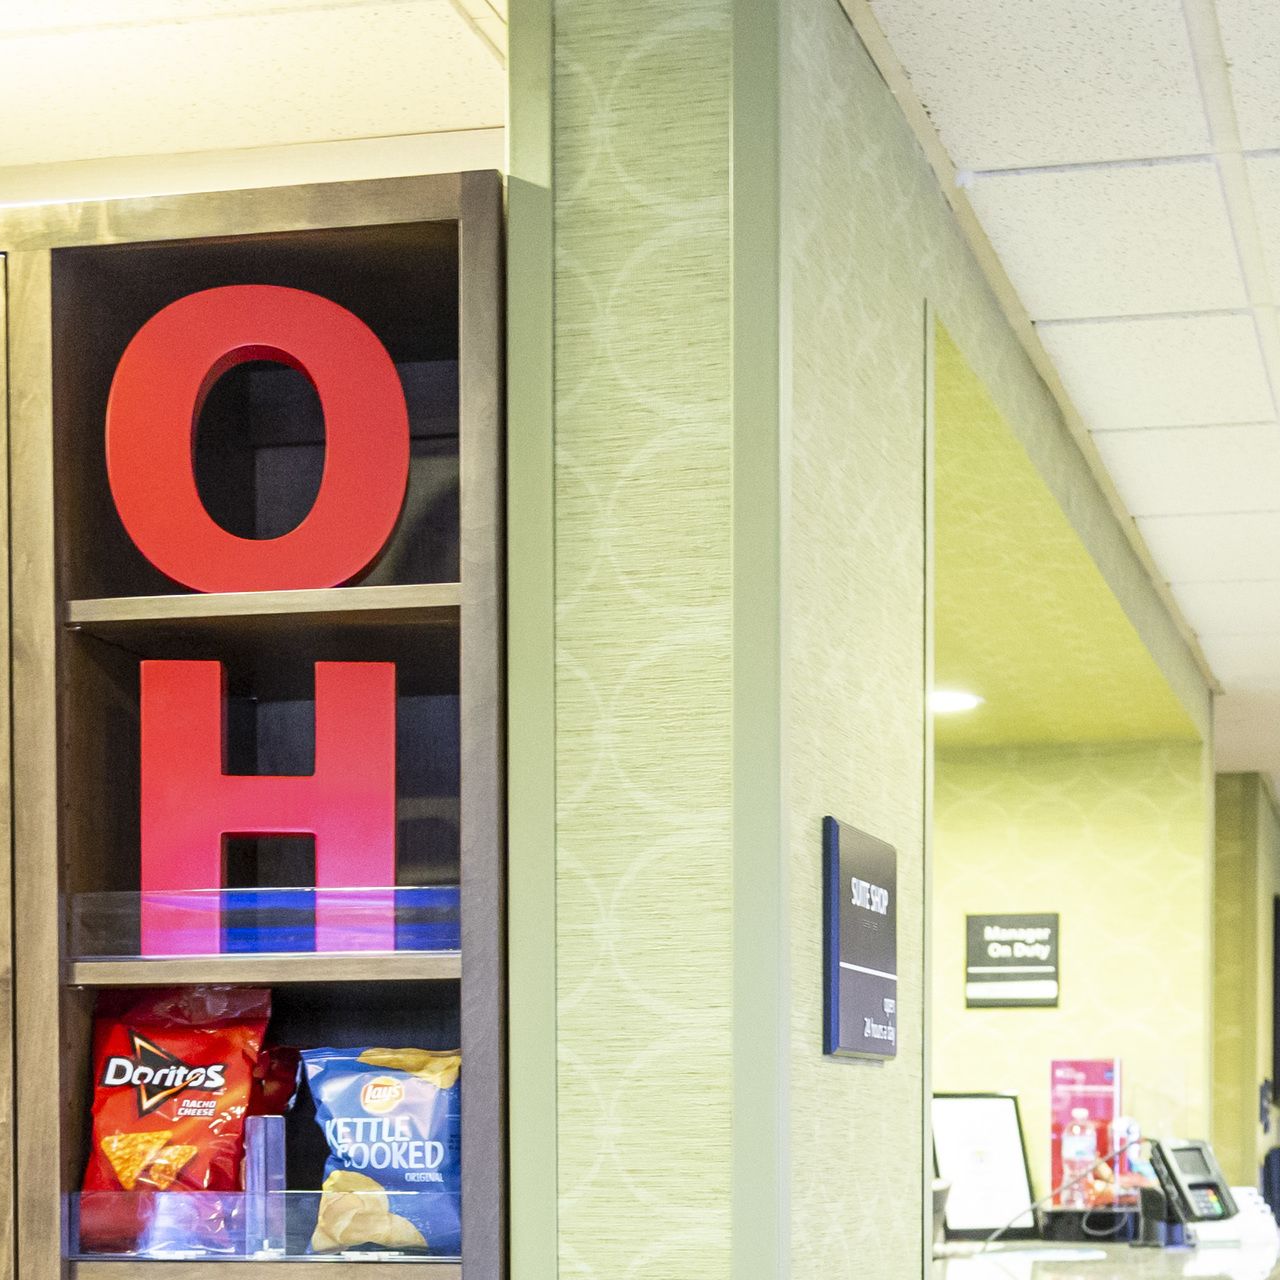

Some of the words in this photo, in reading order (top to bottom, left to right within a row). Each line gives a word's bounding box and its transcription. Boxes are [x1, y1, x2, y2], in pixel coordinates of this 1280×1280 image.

[106, 284, 410, 594] O
[140, 660, 396, 955] H
[984, 926, 1050, 943] Manager
[987, 943, 1012, 958] On
[1013, 942, 1050, 960] Duty
[105, 1057, 225, 1089] Doritos
[177, 1107, 216, 1117] CHEESE
[181, 1099, 217, 1109] NACHO
[325, 1116, 412, 1150] KETTLE
